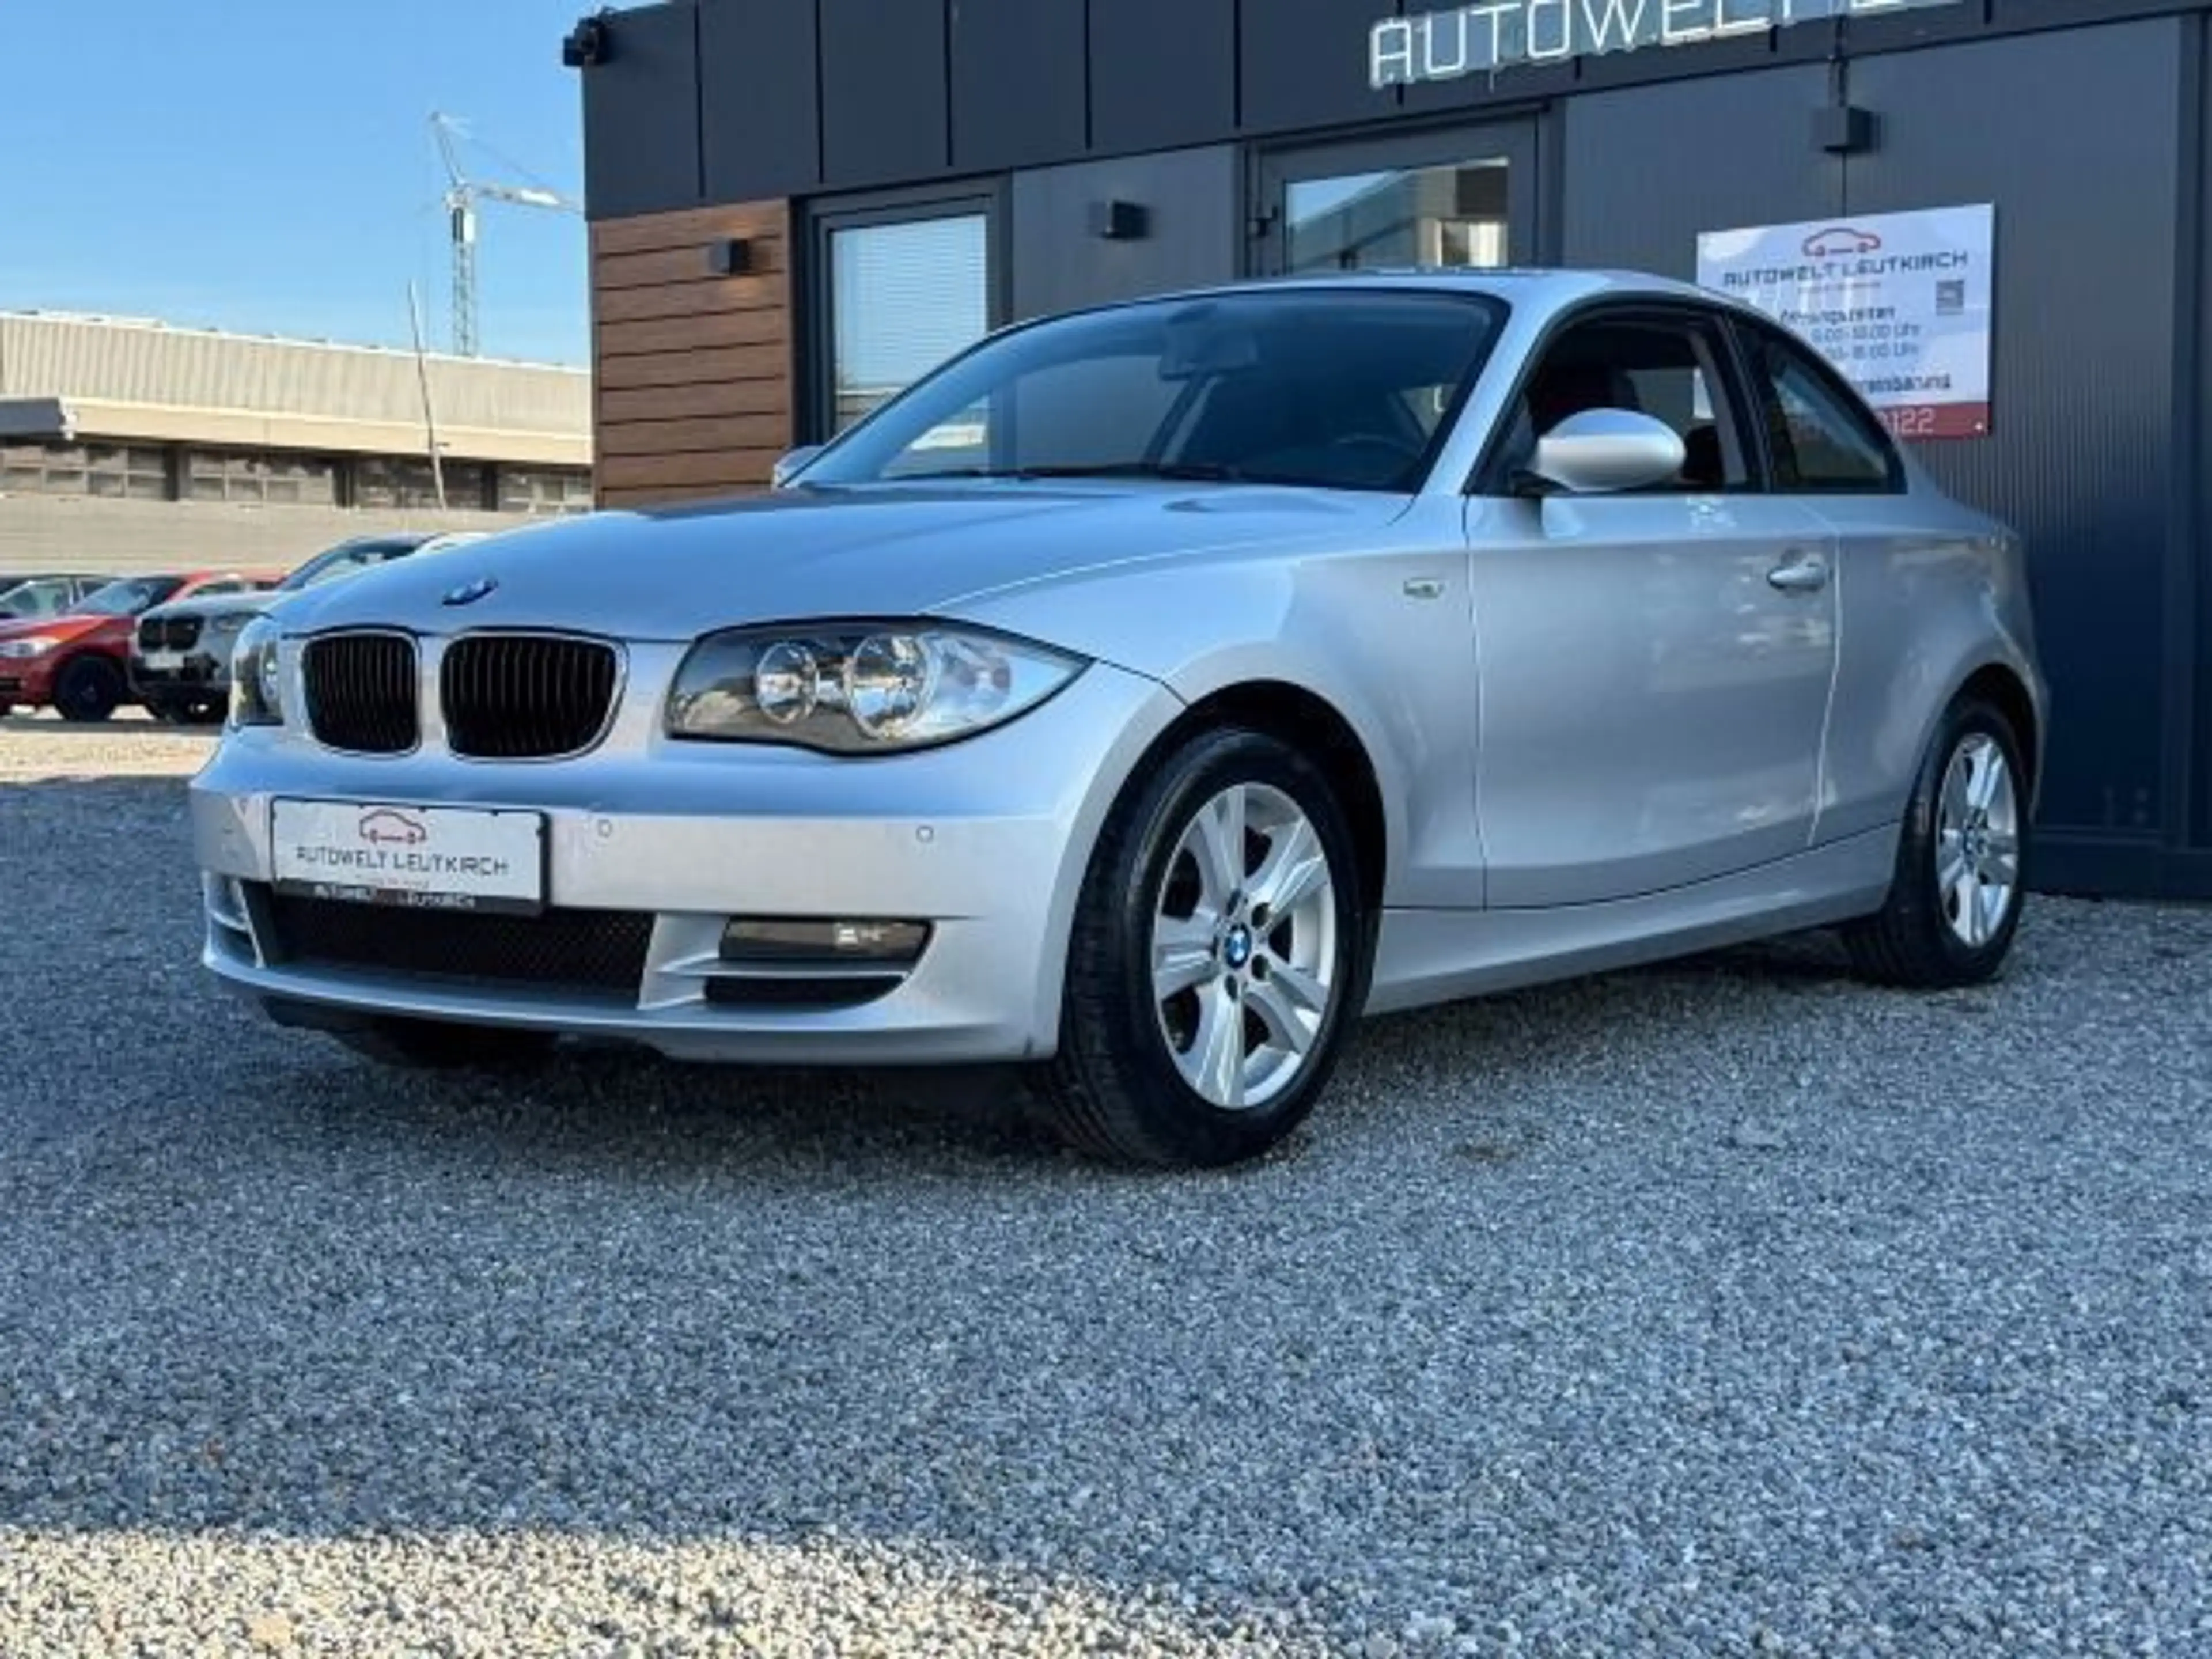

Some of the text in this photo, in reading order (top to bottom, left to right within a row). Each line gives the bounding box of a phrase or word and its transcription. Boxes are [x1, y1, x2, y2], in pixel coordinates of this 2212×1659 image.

[1724, 250, 1968, 287] AUTOWELT LEUTKIRCH
[296, 845, 510, 876] AUTOWELT LEUTKIRCH
